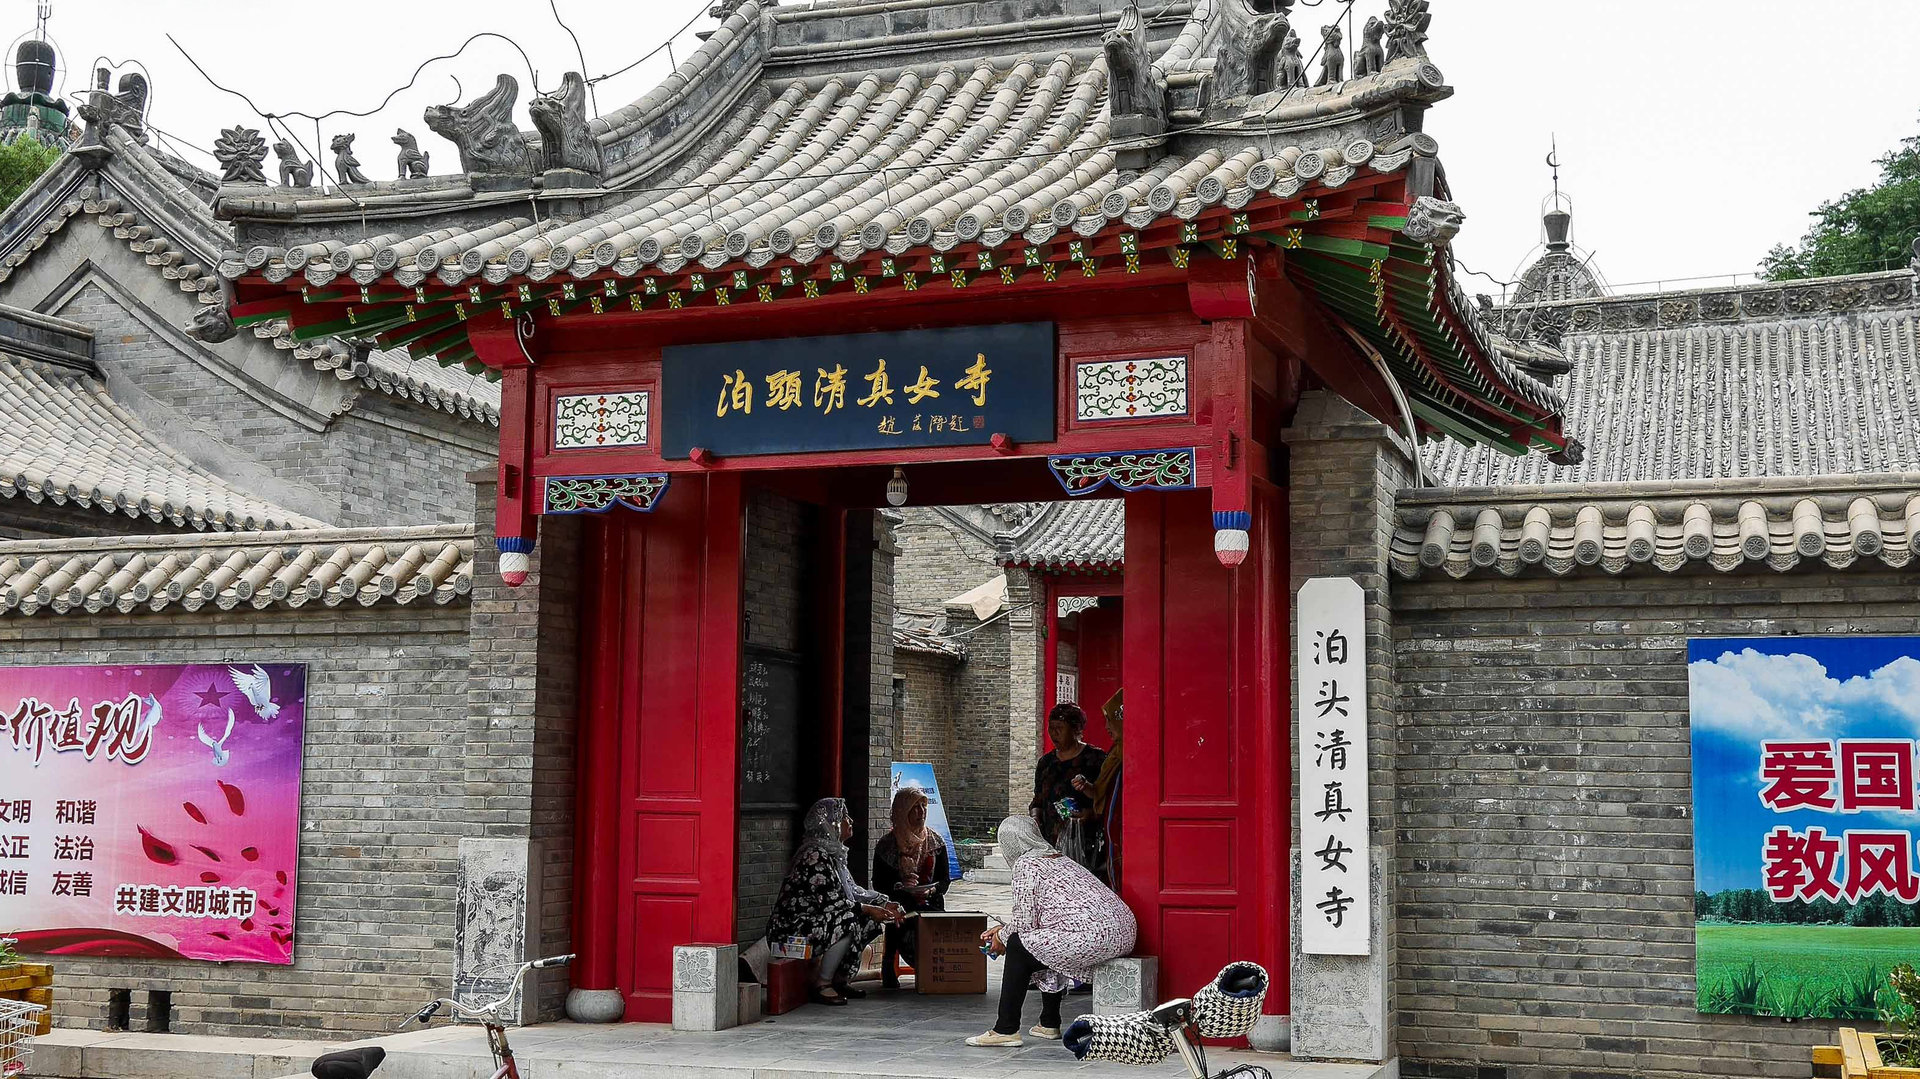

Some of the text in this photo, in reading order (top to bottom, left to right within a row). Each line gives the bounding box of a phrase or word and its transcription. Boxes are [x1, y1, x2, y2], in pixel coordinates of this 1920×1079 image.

[716, 353, 992, 418] 泊頭清真女寺
[0, 698, 149, 762] 价值观
[1313, 629, 1354, 929] 泊头清真女寺
[1763, 742, 1920, 810] 爱国
[56, 800, 97, 825] 和谐
[54, 835, 95, 861] 法治
[1766, 831, 1920, 900] 教风
[52, 871, 93, 897] 友善
[117, 887, 254, 916] 共建文明城市
